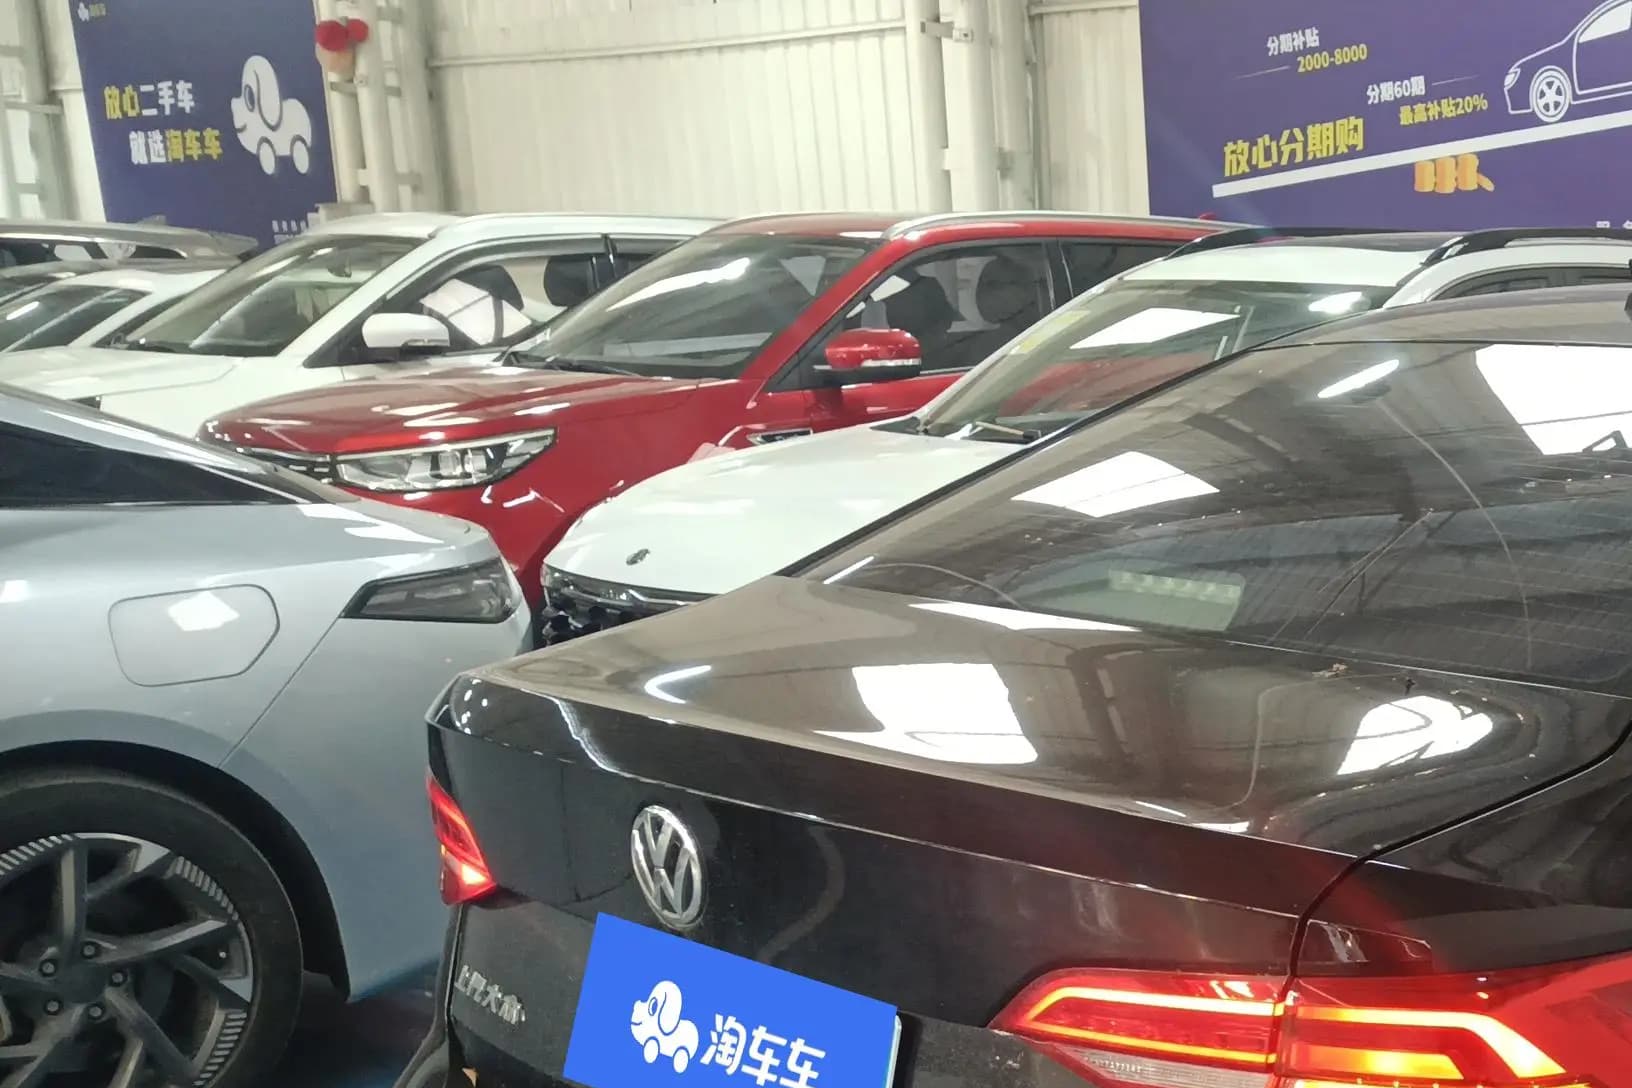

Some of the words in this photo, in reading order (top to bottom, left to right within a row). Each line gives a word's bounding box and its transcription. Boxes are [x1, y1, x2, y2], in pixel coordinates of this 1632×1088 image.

[1267, 27, 1319, 55] 分期补贴
[1297, 44, 1367, 72] 2000-8000
[104, 80, 195, 119] 放心二手车
[1366, 75, 1425, 104] 分期60期
[1400, 94, 1488, 125] 最高补贴20%
[1224, 115, 1365, 176] 放心分期购
